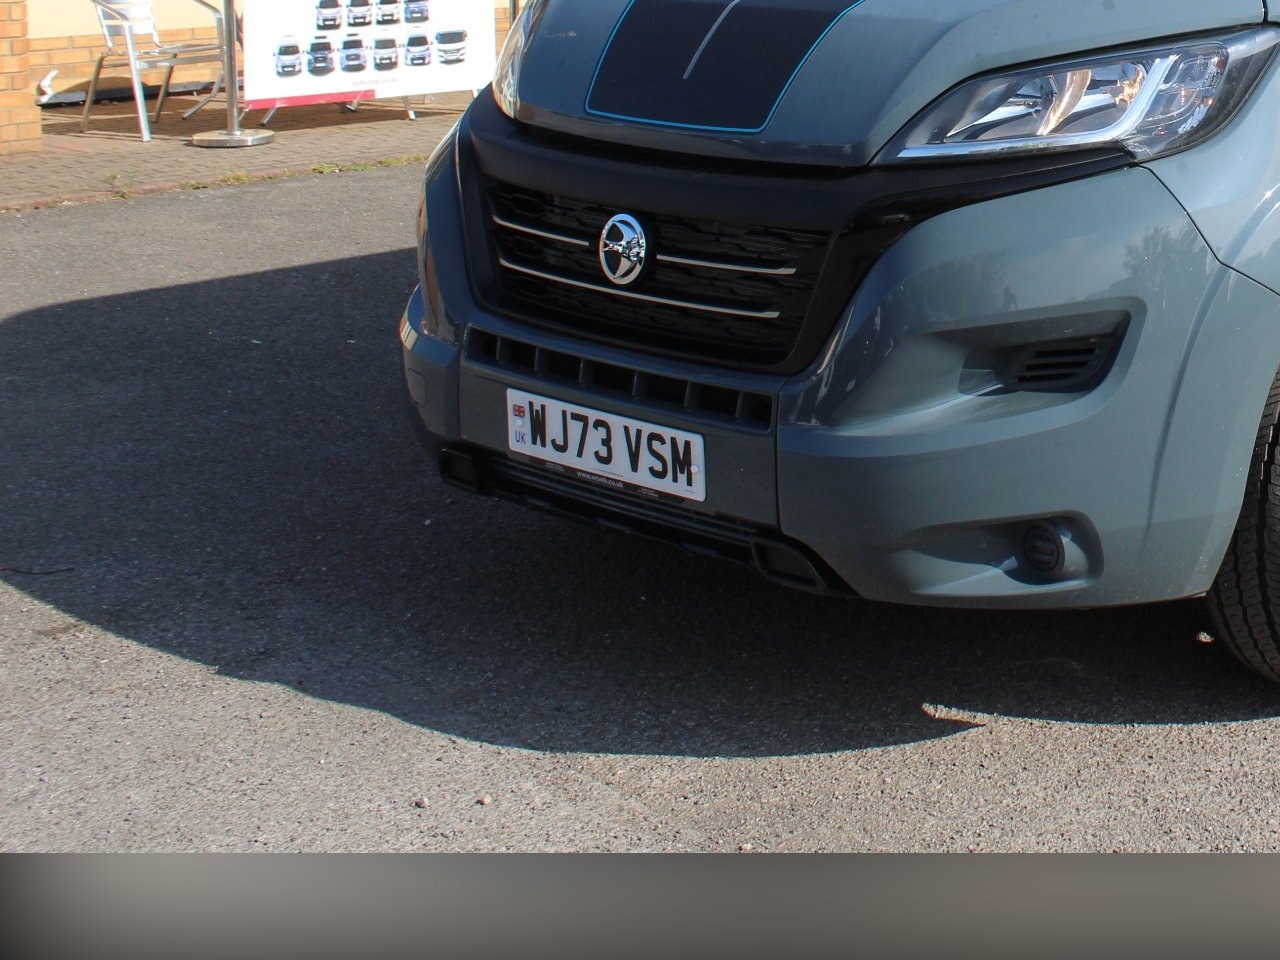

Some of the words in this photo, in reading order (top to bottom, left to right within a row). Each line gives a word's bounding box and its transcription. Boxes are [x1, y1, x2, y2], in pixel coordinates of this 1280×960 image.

[514, 430, 526, 445] UK
[529, 401, 613, 465] WJ73
[623, 425, 693, 487] VSM
